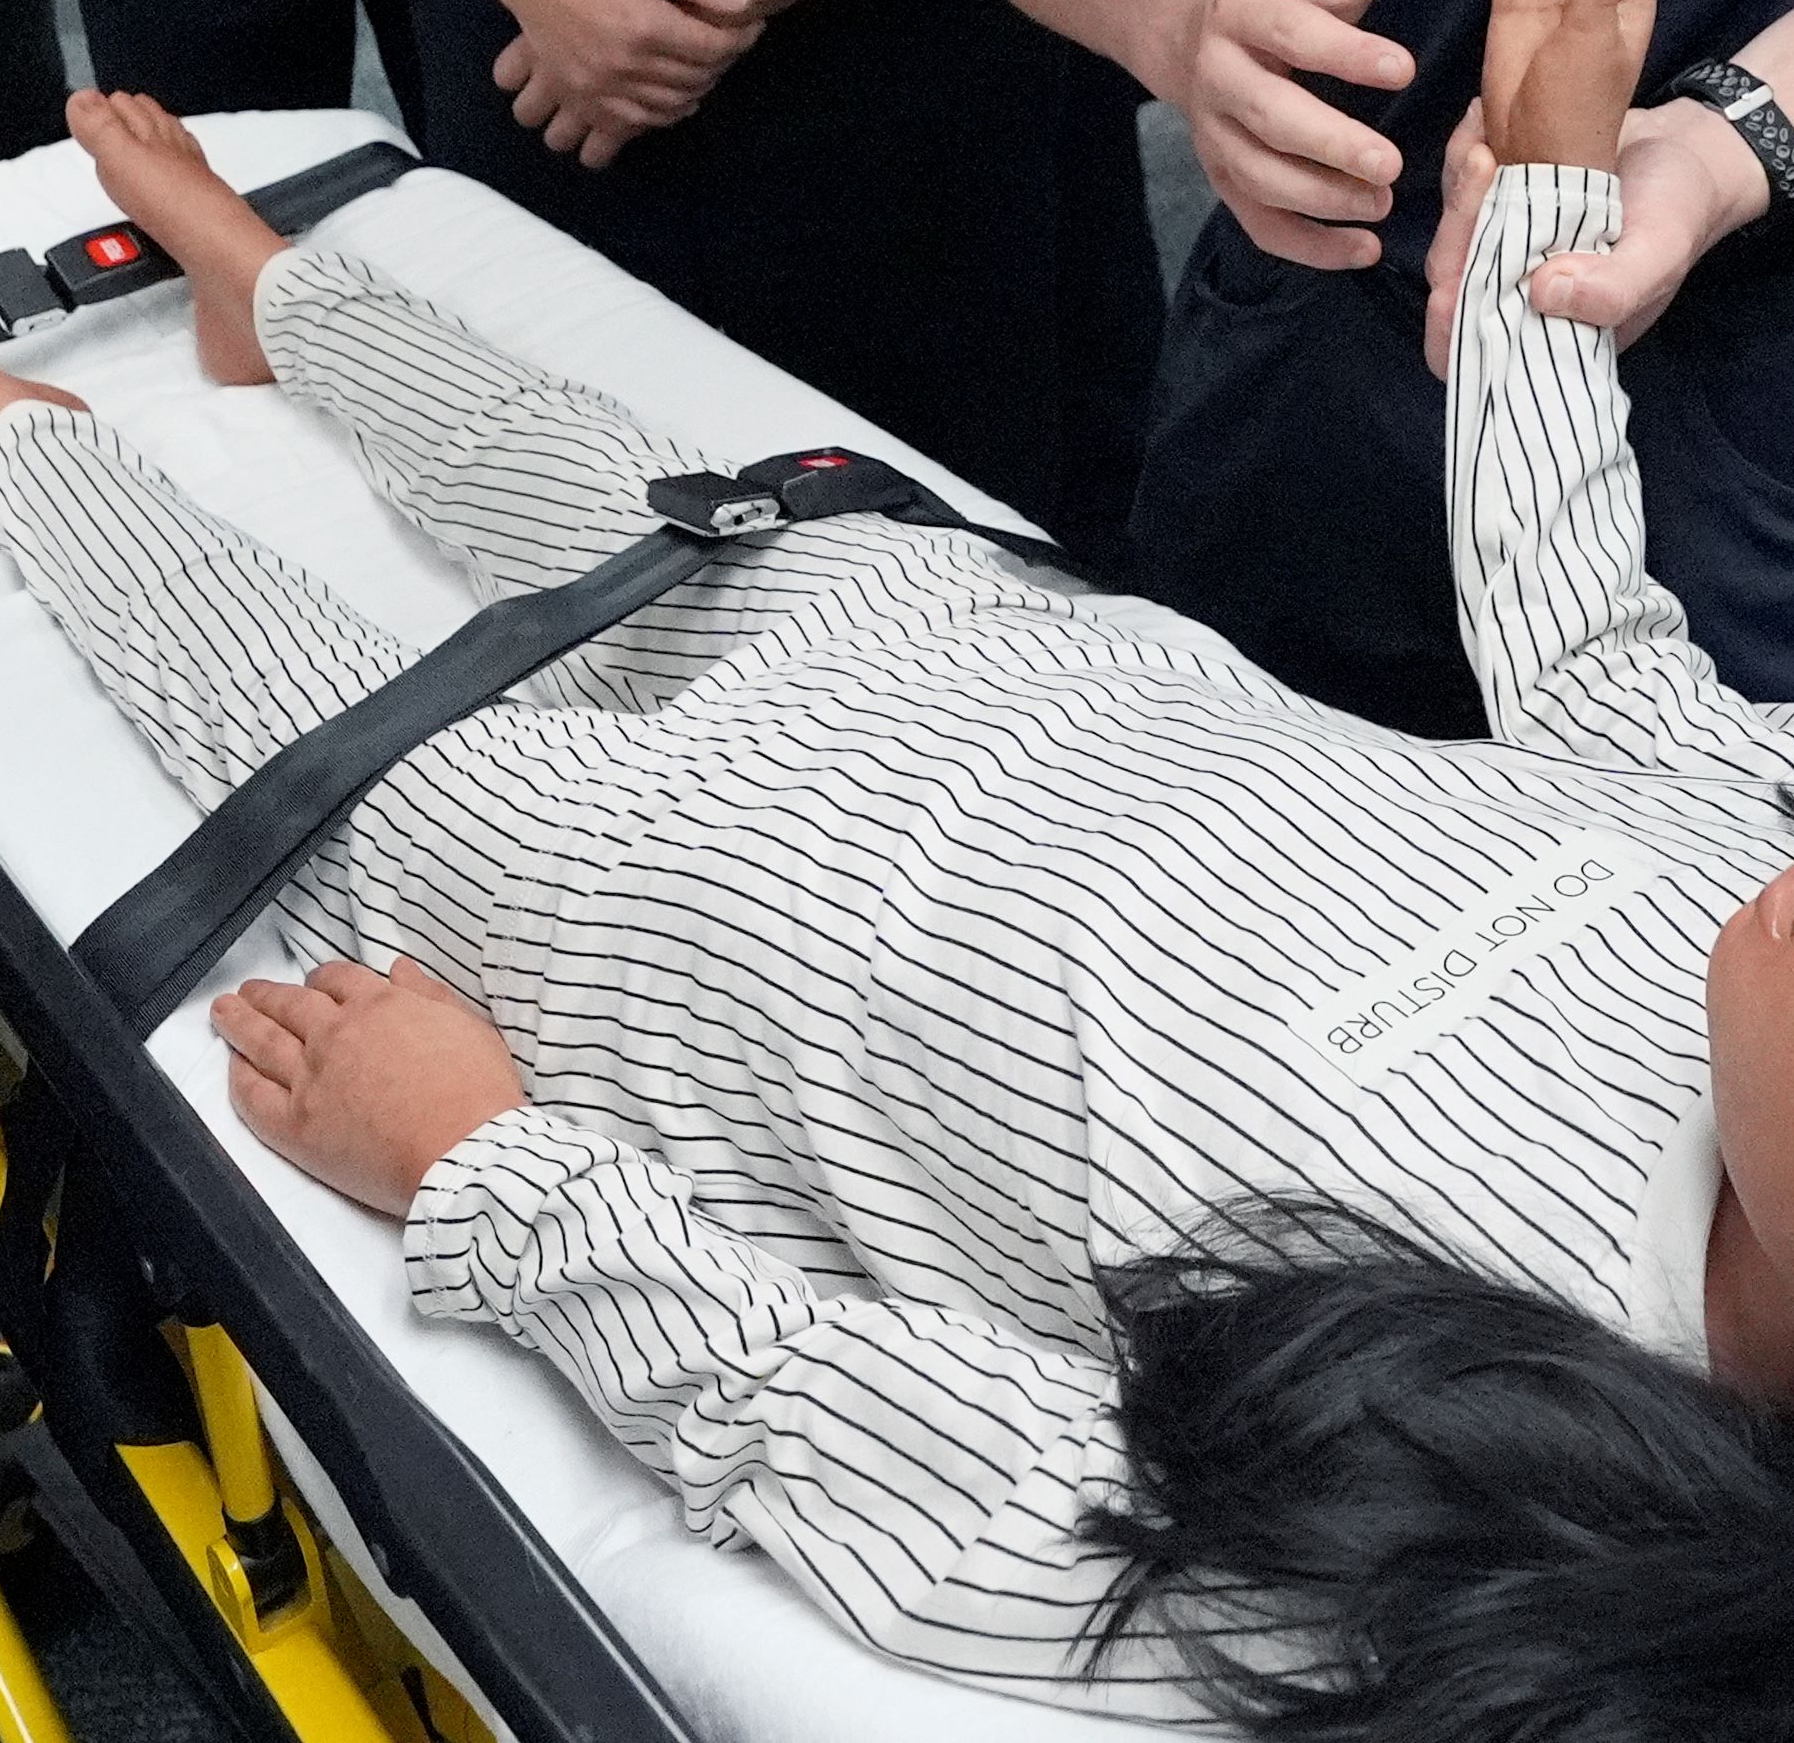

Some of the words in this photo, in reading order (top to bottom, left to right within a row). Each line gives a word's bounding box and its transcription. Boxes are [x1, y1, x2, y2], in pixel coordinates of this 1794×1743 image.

[1553, 859, 1615, 898] DO
[1475, 894, 1555, 952] NOT
[1327, 948, 1478, 1054] DISTURB
